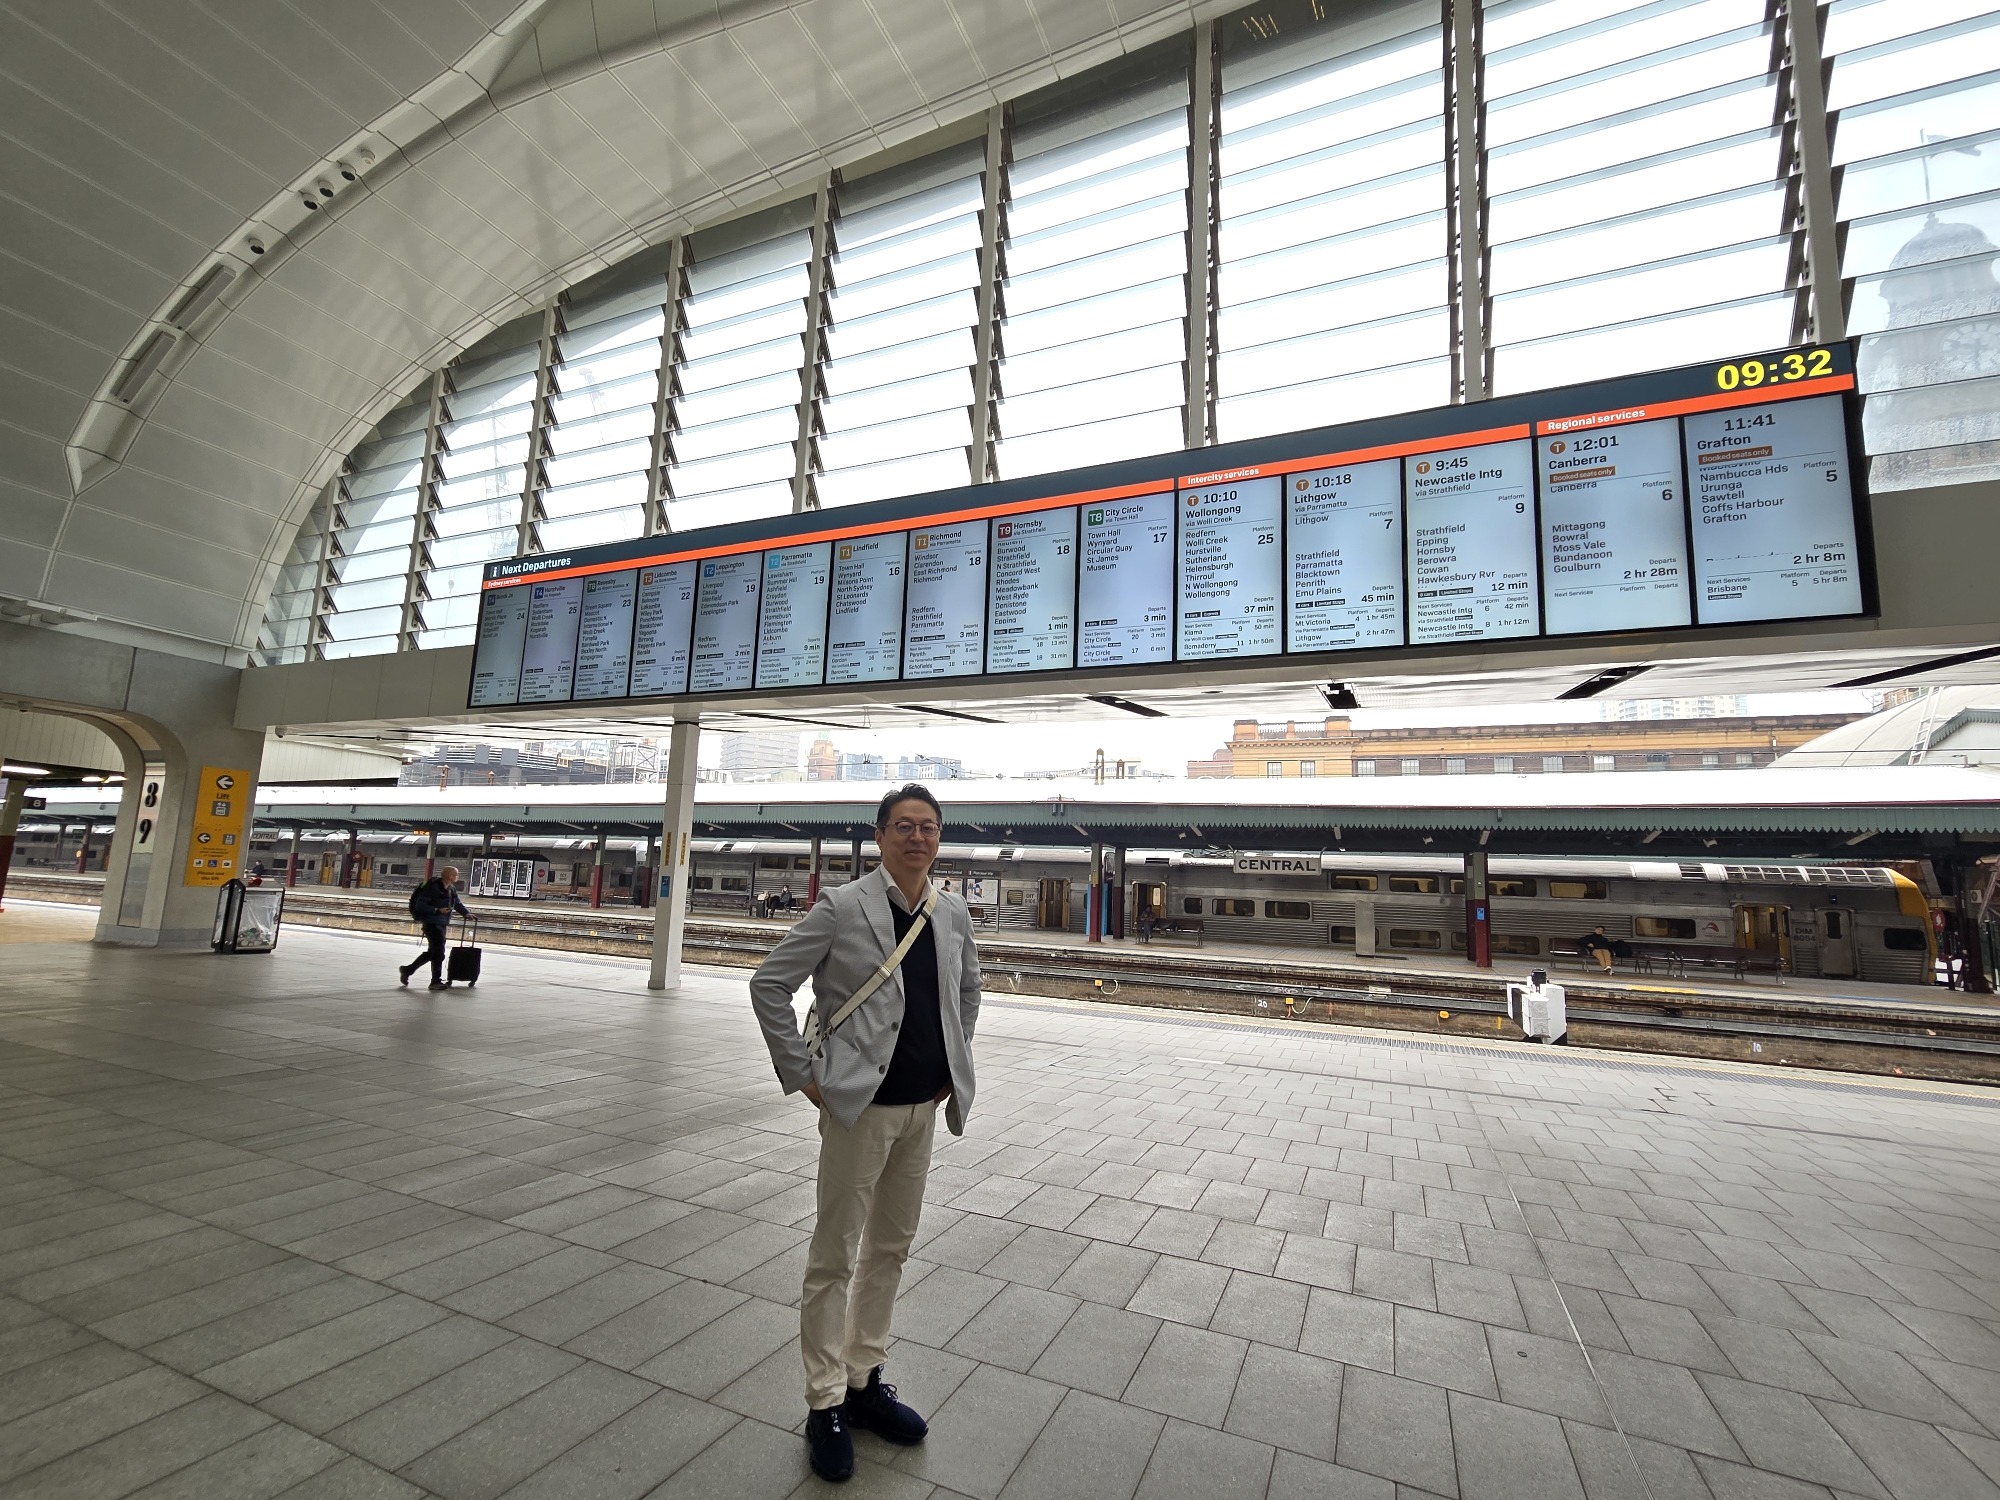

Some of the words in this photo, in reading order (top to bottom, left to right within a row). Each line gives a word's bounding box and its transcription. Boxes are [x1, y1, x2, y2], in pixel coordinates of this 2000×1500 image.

[1717, 349, 1833, 390] 09:32
[1548, 415, 1596, 431] Regional
[1598, 409, 1646, 423] services
[1724, 413, 1776, 431] 11:41
[1573, 436, 1619, 452] 12:01
[1697, 435, 1751, 450] Grafton
[1702, 453, 1731, 463] Booked
[1731, 451, 1752, 459] seats
[1753, 448, 1769, 457] only
[1436, 457, 1468, 471] 9:45
[1549, 454, 1607, 470] Canberra
[1803, 460, 1837, 469] Platform
[1188, 473, 1223, 484] Intercity
[1224, 468, 1259, 479] services
[1415, 472, 1476, 488] Newcastle
[1480, 469, 1503, 479] Intg
[1553, 472, 1579, 482] Booked
[1598, 468, 1613, 476] only
[1700, 469, 1762, 483] Nambucca
[1765, 464, 1789, 474] Hds
[1826, 469, 1838, 483] 5
[1314, 474, 1352, 489] 10:18
[1642, 480, 1672, 488] Platform
[1701, 481, 1743, 493] Urunga
[1429, 483, 1471, 495] Strathfield
[1550, 481, 1597, 494] Canberra
[1204, 491, 1237, 504] 10:10
[1295, 492, 1337, 504] Lithgow
[1662, 489, 1672, 500] 6
[1701, 490, 1745, 504] Sawtell
[1307, 501, 1347, 511] Parramatta
[1515, 503, 1524, 513] 9
[1702, 502, 1733, 514] Coffs
[1736, 497, 1785, 510] Harbour
[1090, 513, 1102, 522] T8
[1122, 505, 1143, 514] Circle
[1186, 505, 1241, 518] Wollongong
[1295, 515, 1329, 525] Lithgow
[1703, 512, 1747, 524] Grafton
[1000, 526, 1011, 535] T9
[1014, 520, 1043, 529] Hornsby
[1384, 519, 1393, 529] 7
[1552, 521, 1606, 533] Mittagong
[1186, 530, 1215, 538] Redfern
[1416, 524, 1466, 537] Strathfield
[917, 538, 927, 546] T1
[930, 531, 962, 541] Richmond
[1088, 538, 1117, 548] Wynyard
[1154, 533, 1167, 543] 17
[1206, 536, 1228, 545] Creek
[1258, 534, 1273, 545] 25
[1416, 537, 1449, 547] Epping
[1552, 532, 1589, 543] Bowral
[1057, 545, 1070, 555] 18
[1186, 546, 1221, 556] Hurstville
[1417, 546, 1456, 556] Hornsby
[1553, 543, 1581, 553] Moss
[1583, 540, 1606, 550] Vale
[1813, 542, 1844, 550] Departs
[1186, 554, 1227, 564] Sutherland
[1295, 548, 1339, 561] Strathfield
[1553, 550, 1613, 563] Bundanoon
[1793, 556, 1802, 564] 2
[1806, 554, 1820, 563] hr
[1823, 552, 1845, 561] 8m
[969, 557, 981, 566] 18
[1295, 559, 1343, 570] Parramatta
[1417, 555, 1457, 566] Berowra
[1649, 557, 1677, 565] Departs
[502, 565, 521, 575] Next
[523, 558, 571, 572] Departures
[889, 567, 900, 576] 16
[1087, 563, 1116, 572] Museum
[1185, 562, 1233, 573] Helensburgh
[1417, 566, 1449, 575] Cowan
[1553, 562, 1601, 574] Goulburn
[1185, 572, 1214, 582] Thirroul
[1295, 569, 1340, 579] Blacktown
[1417, 572, 1477, 585] Hawkesbury
[1479, 570, 1496, 579] Rvr
[1624, 570, 1631, 579] 2
[1634, 570, 1647, 578] hr
[1650, 567, 1678, 577] 28m
[814, 576, 824, 584] 19
[1295, 579, 1326, 588] Penrith
[746, 584, 755, 592] 19
[1492, 583, 1505, 591] 12
[1508, 581, 1528, 590] min
[1707, 584, 1748, 593] Brisbane
[681, 592, 690, 600] 22
[1185, 589, 1230, 599] Wollongong
[1295, 589, 1314, 597] Emu
[1316, 587, 1342, 595] Plains
[1377, 593, 1394, 601] min
[1258, 604, 1274, 612] min
[1417, 608, 1456, 617] Newcastle
[1152, 613, 1166, 621] min
[144, 782, 159, 807] 8
[138, 819, 152, 844] 9
[1239, 859, 1316, 871] CENTRAL
[1258, 1000, 1268, 1008] 20
